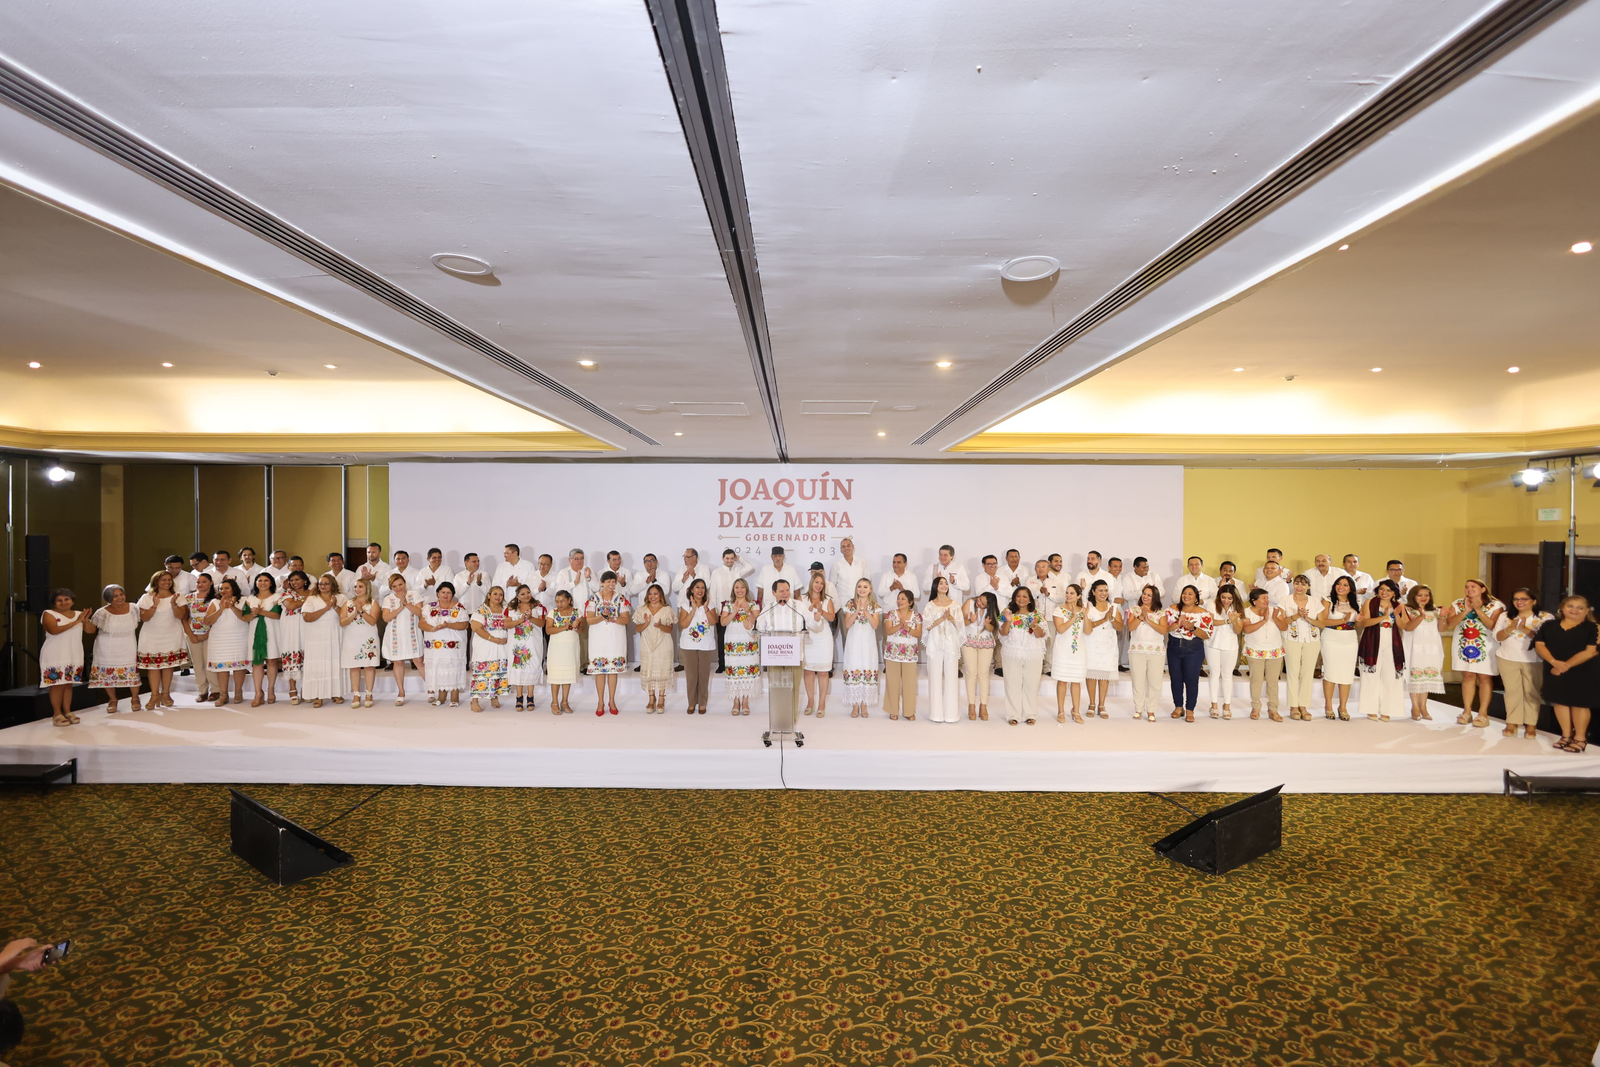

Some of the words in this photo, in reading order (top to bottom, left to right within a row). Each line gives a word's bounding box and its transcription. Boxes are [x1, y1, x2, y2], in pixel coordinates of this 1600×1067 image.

[718, 471, 854, 508] JOAQUÍN
[718, 506, 774, 528] DÍAZ
[783, 511, 854, 528] MENA
[745, 533, 826, 542] GOBERNADOR
